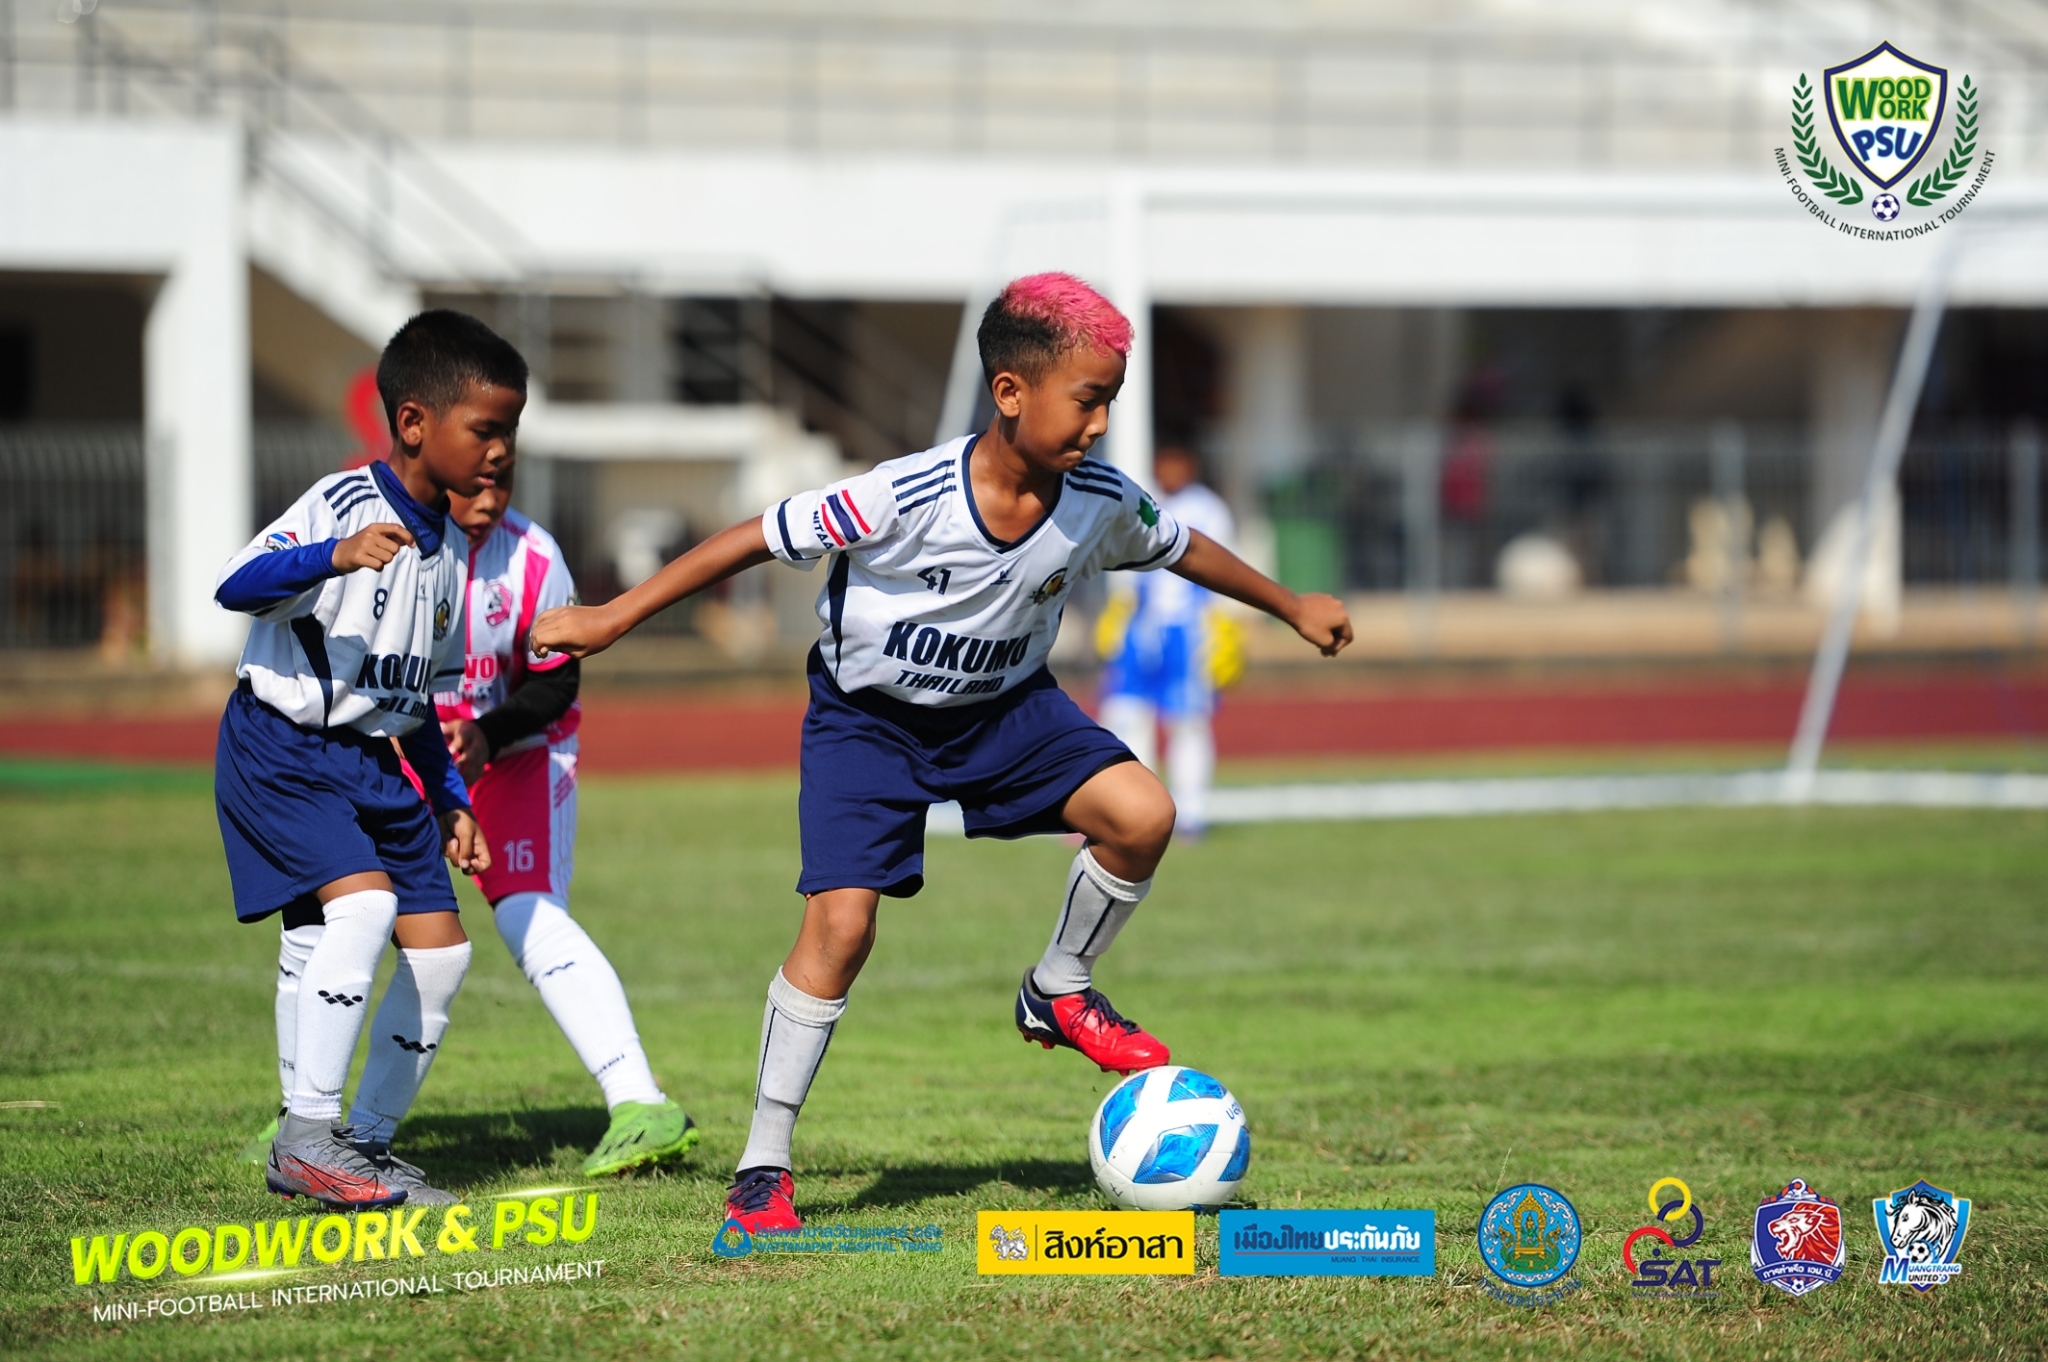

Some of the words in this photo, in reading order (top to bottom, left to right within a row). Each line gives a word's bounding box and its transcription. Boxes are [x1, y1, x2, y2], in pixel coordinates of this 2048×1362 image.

[917, 566, 952, 595] 41
[373, 588, 388, 620] 8
[882, 621, 1033, 674] KOKUMO
[894, 669, 1006, 695] THAILAND
[503, 839, 535, 873] 16
